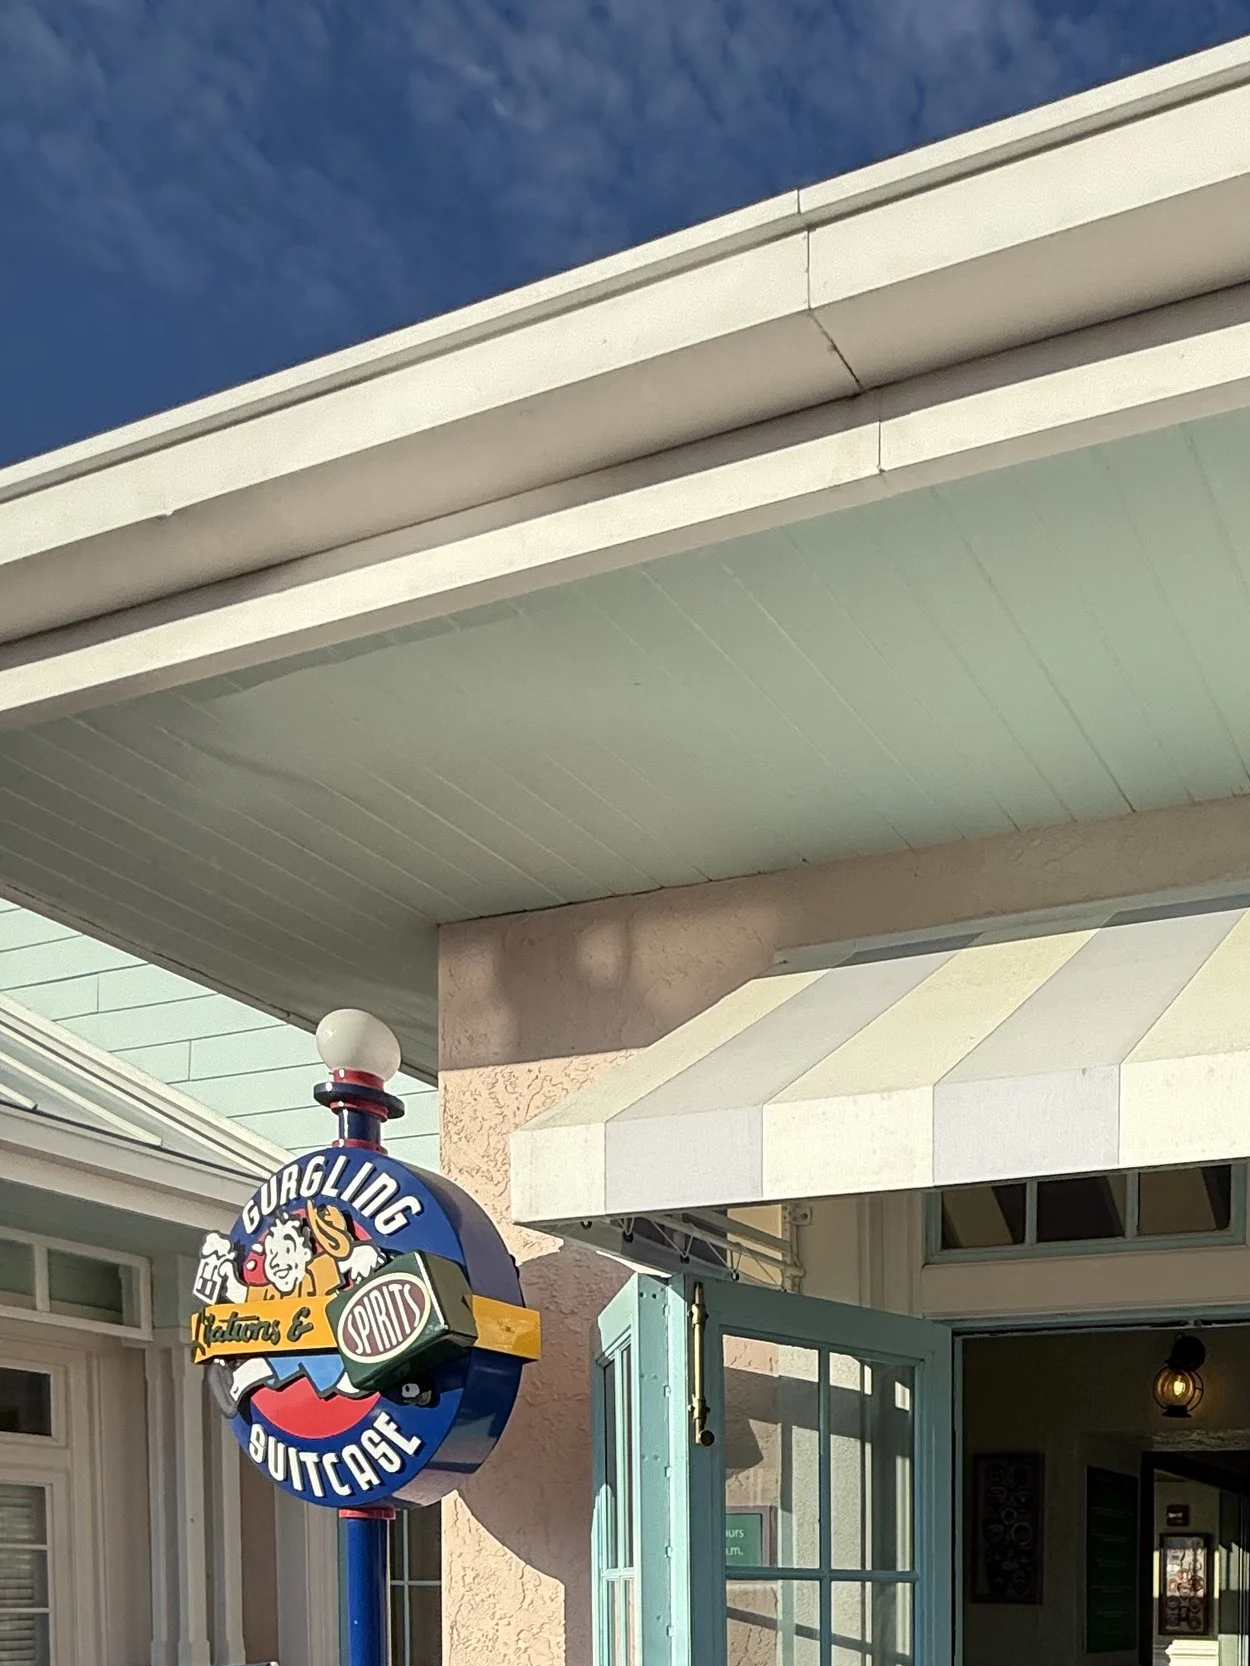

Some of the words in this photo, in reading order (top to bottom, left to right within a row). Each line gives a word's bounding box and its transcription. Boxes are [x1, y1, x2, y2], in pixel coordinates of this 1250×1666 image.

[242, 1155, 422, 1236] GURGLING
[287, 1307, 314, 1343] &
[347, 1283, 421, 1355] SPIRITS
[249, 1411, 421, 1498] SUITCASE
